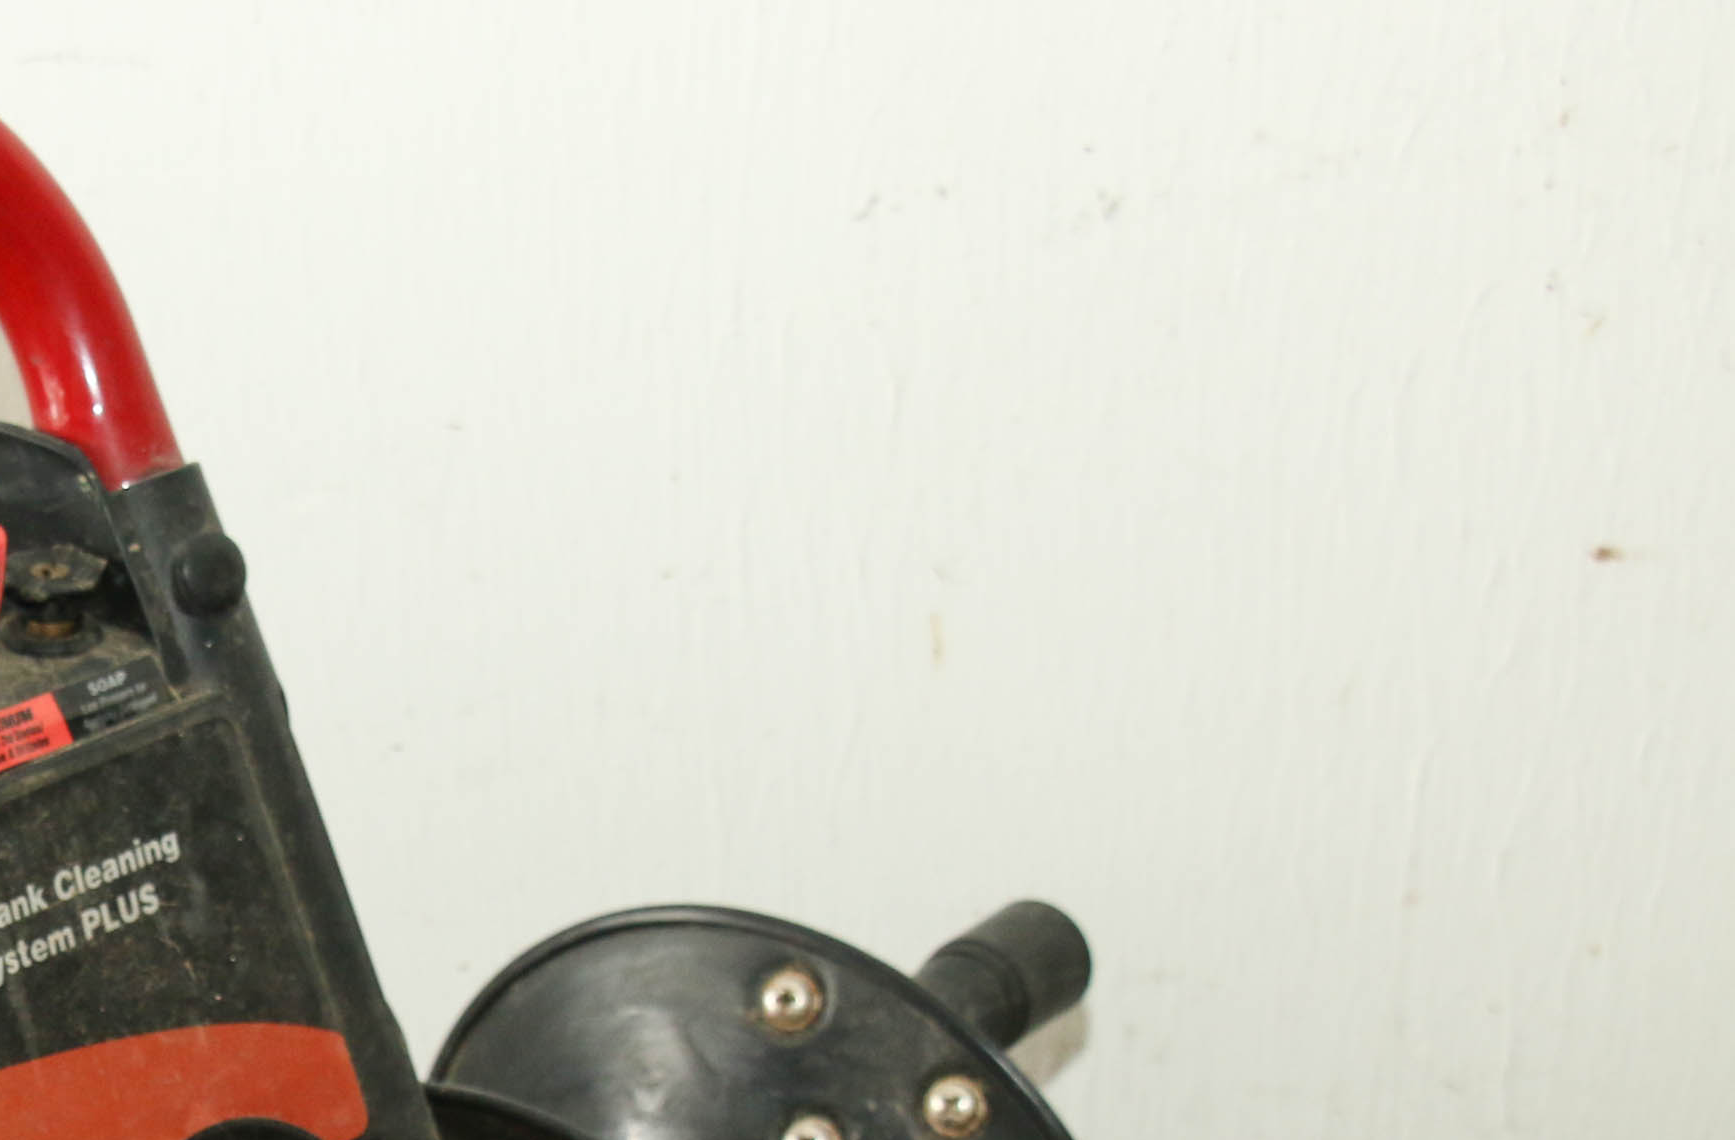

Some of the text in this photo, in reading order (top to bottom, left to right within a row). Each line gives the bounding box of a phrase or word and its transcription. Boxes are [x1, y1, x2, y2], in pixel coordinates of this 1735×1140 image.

[87, 670, 127, 697] SOAP
[53, 832, 180, 901] Cleaning
[81, 882, 160, 941] PLUS
